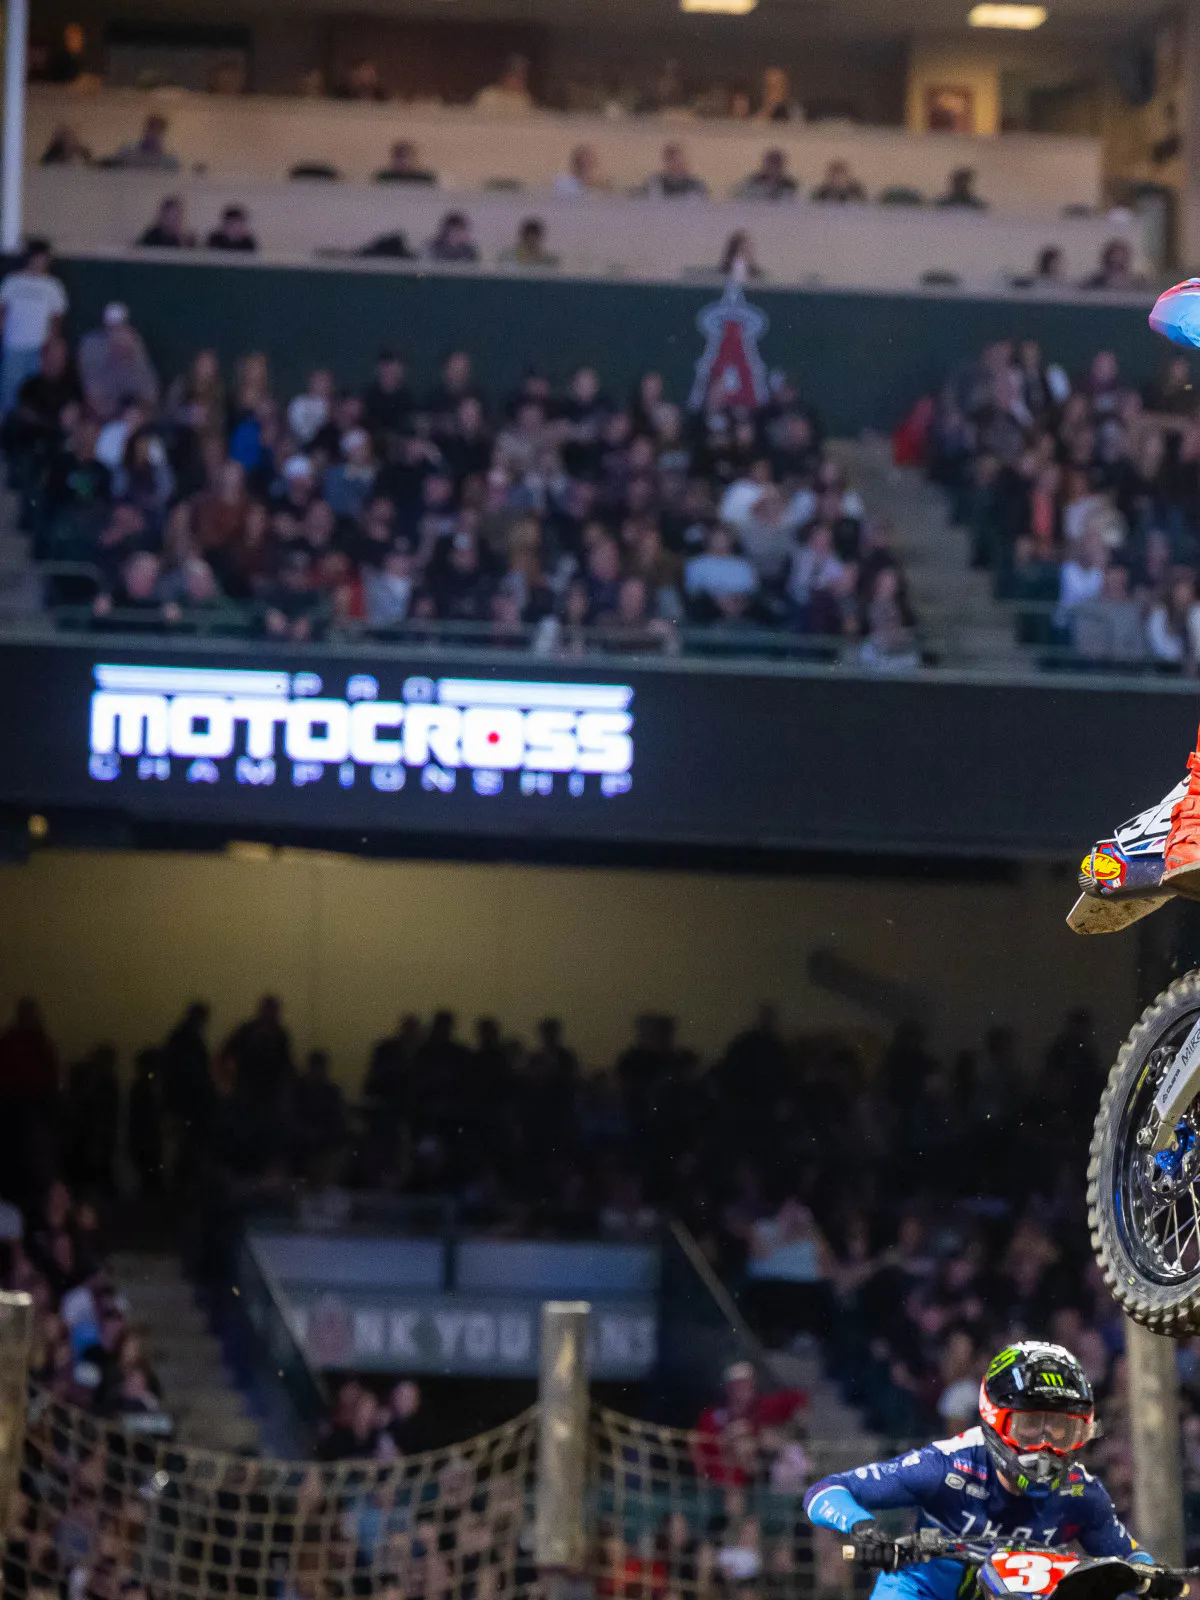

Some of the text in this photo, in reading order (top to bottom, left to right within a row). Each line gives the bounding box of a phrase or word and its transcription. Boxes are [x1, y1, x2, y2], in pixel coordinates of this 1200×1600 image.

[91, 691, 633, 774] MOTOCROSS
[89, 752, 632, 797] CHAMPIONSHIP
[1003, 1554, 1052, 1593] 3
